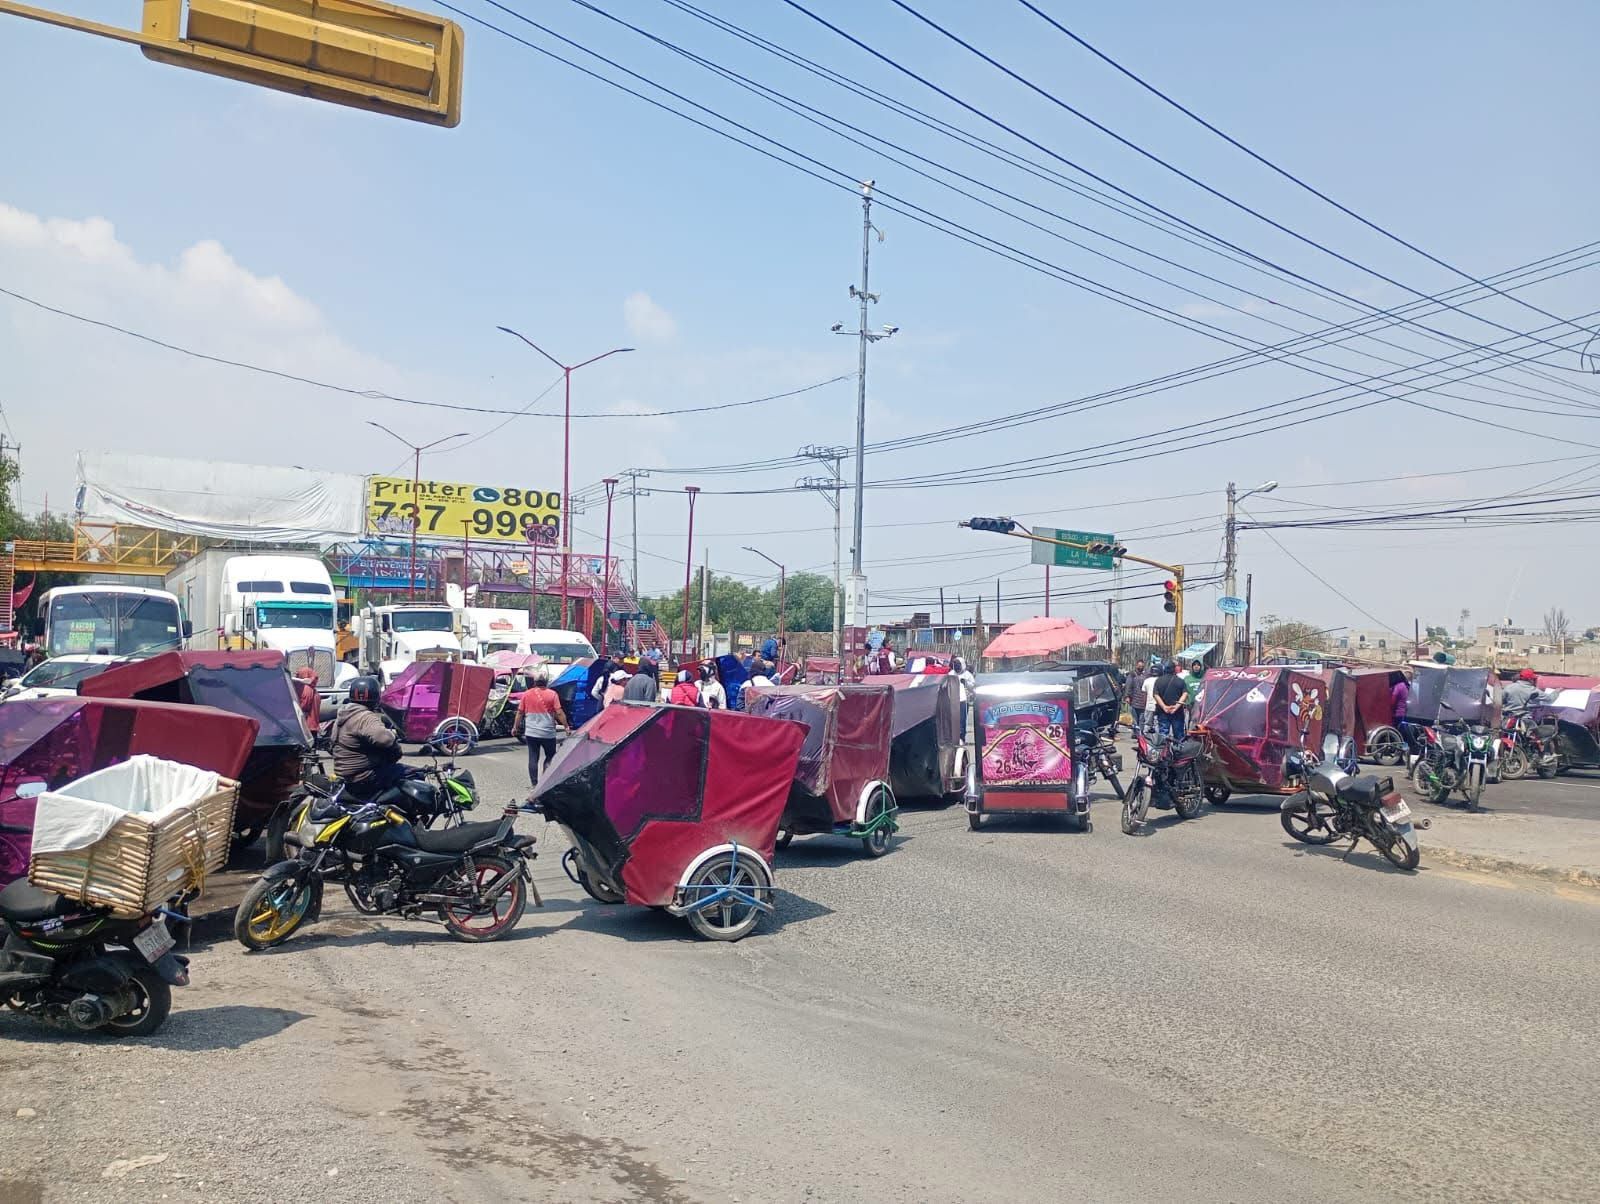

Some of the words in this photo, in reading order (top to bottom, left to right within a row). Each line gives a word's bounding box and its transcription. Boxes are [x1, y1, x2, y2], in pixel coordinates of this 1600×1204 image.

[373, 479, 468, 497] Printer
[502, 488, 560, 510] 800
[374, 501, 446, 531] 737
[472, 508, 560, 540] 9999
[1048, 725, 1061, 738] 26
[996, 759, 1012, 774] 26
